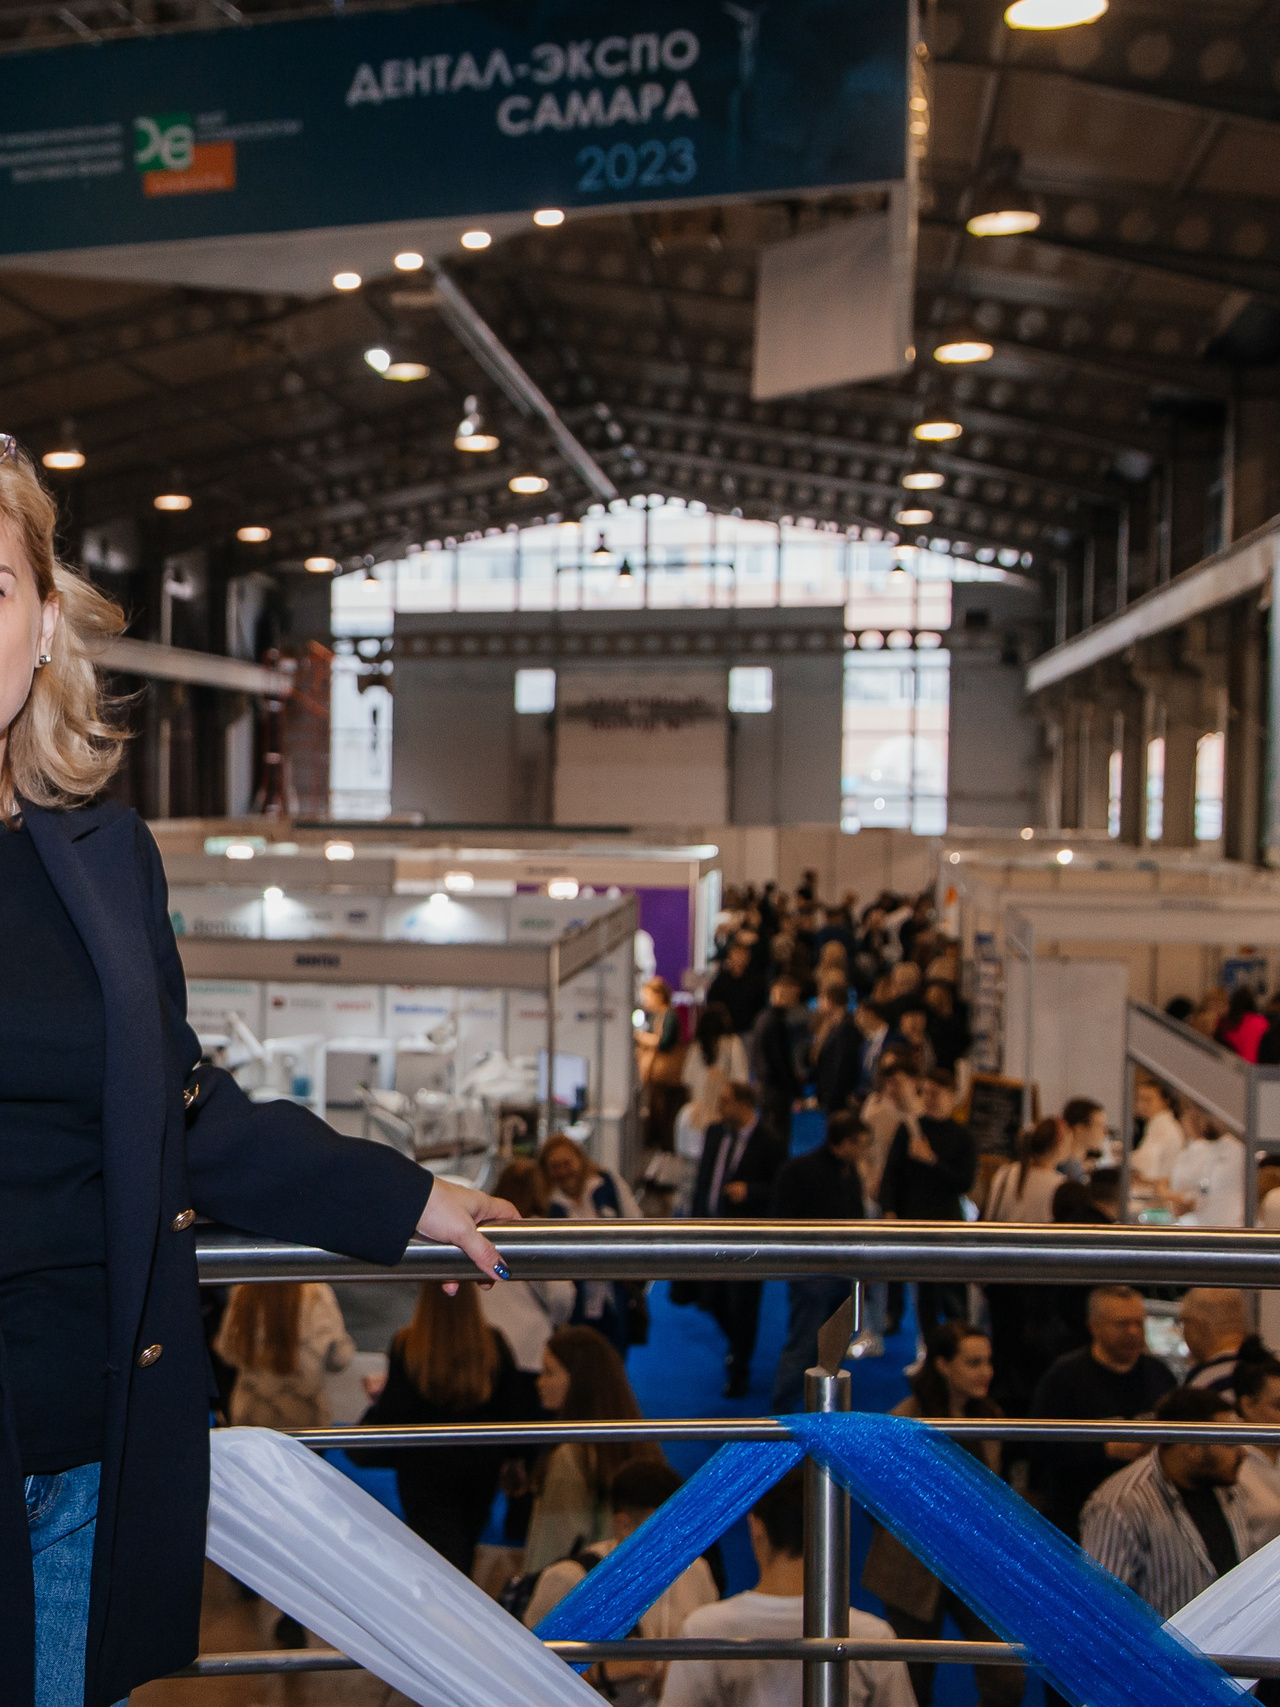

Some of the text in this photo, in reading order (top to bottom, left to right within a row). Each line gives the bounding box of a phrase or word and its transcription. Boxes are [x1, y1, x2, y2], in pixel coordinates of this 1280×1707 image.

[346, 29, 700, 107] ДЕНТАЛ-ЭКСПО
[496, 79, 700, 136] САМАРА
[576, 137, 698, 191] 2023
